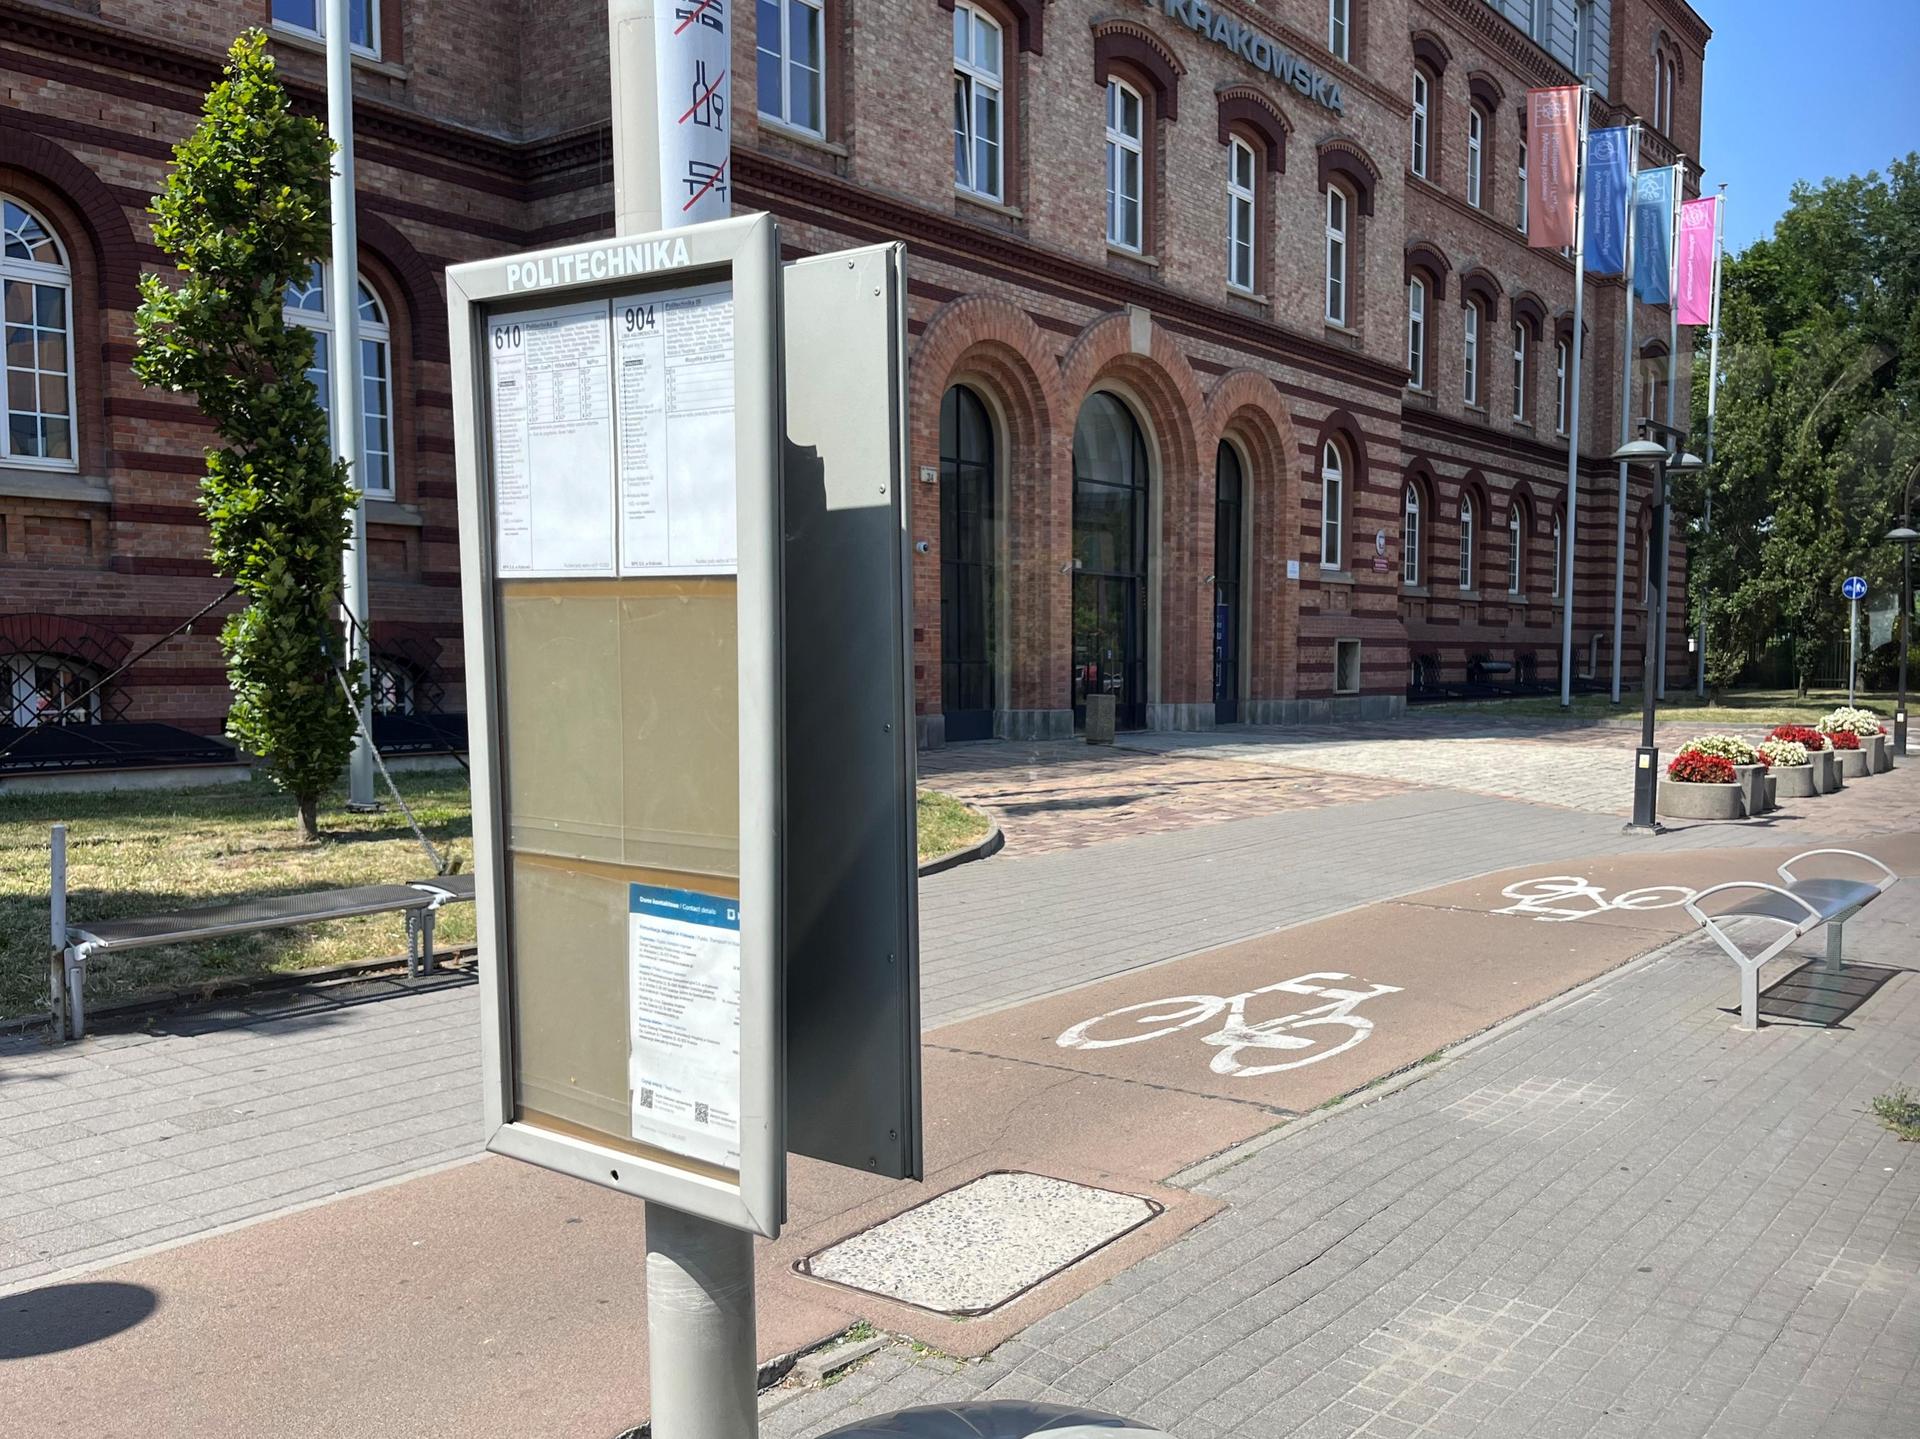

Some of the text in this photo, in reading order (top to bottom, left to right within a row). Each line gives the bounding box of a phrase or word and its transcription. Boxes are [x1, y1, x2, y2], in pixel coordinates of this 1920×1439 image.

[1166, 0, 1345, 117] KRAKOWSKA
[506, 237, 691, 291] POLITECHNIKA
[495, 325, 521, 350] 610
[625, 305, 656, 332] 904
